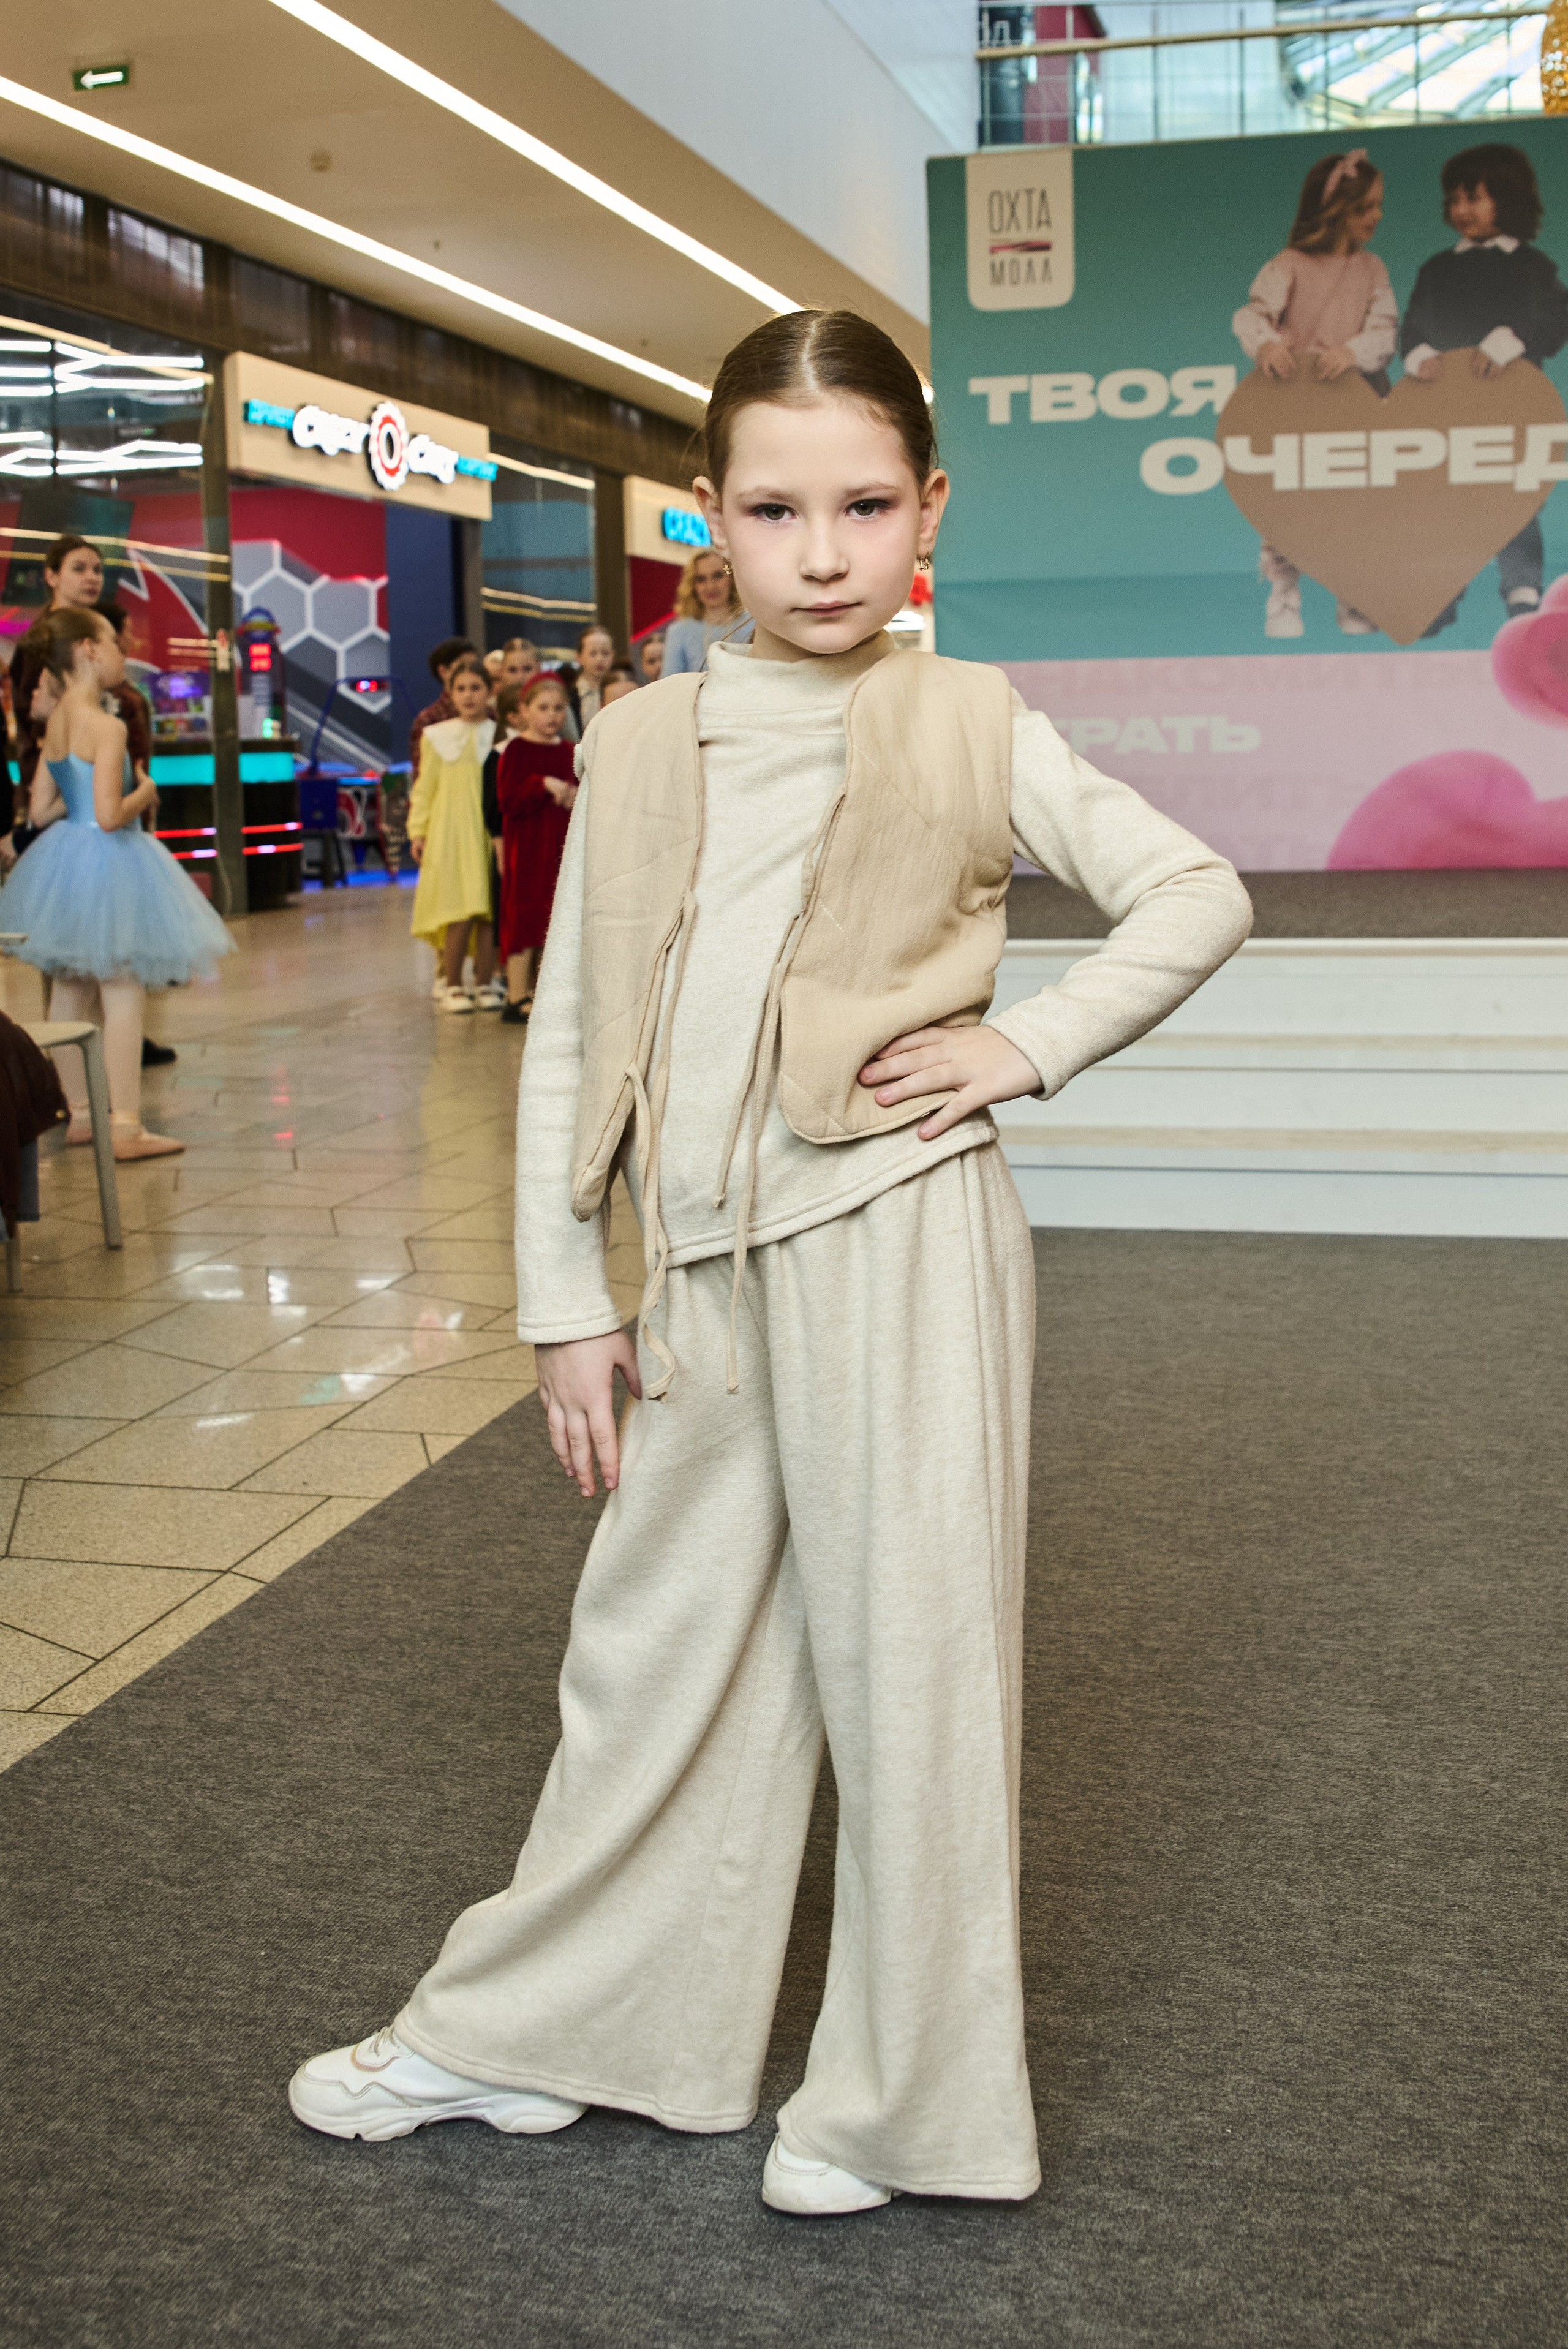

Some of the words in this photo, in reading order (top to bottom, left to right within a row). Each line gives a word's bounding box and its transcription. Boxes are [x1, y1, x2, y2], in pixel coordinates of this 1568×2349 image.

[988, 188, 1052, 234] ОХТА
[990, 257, 1052, 287] МОЛЛ
[968, 365, 1237, 424] ТВОЯ
